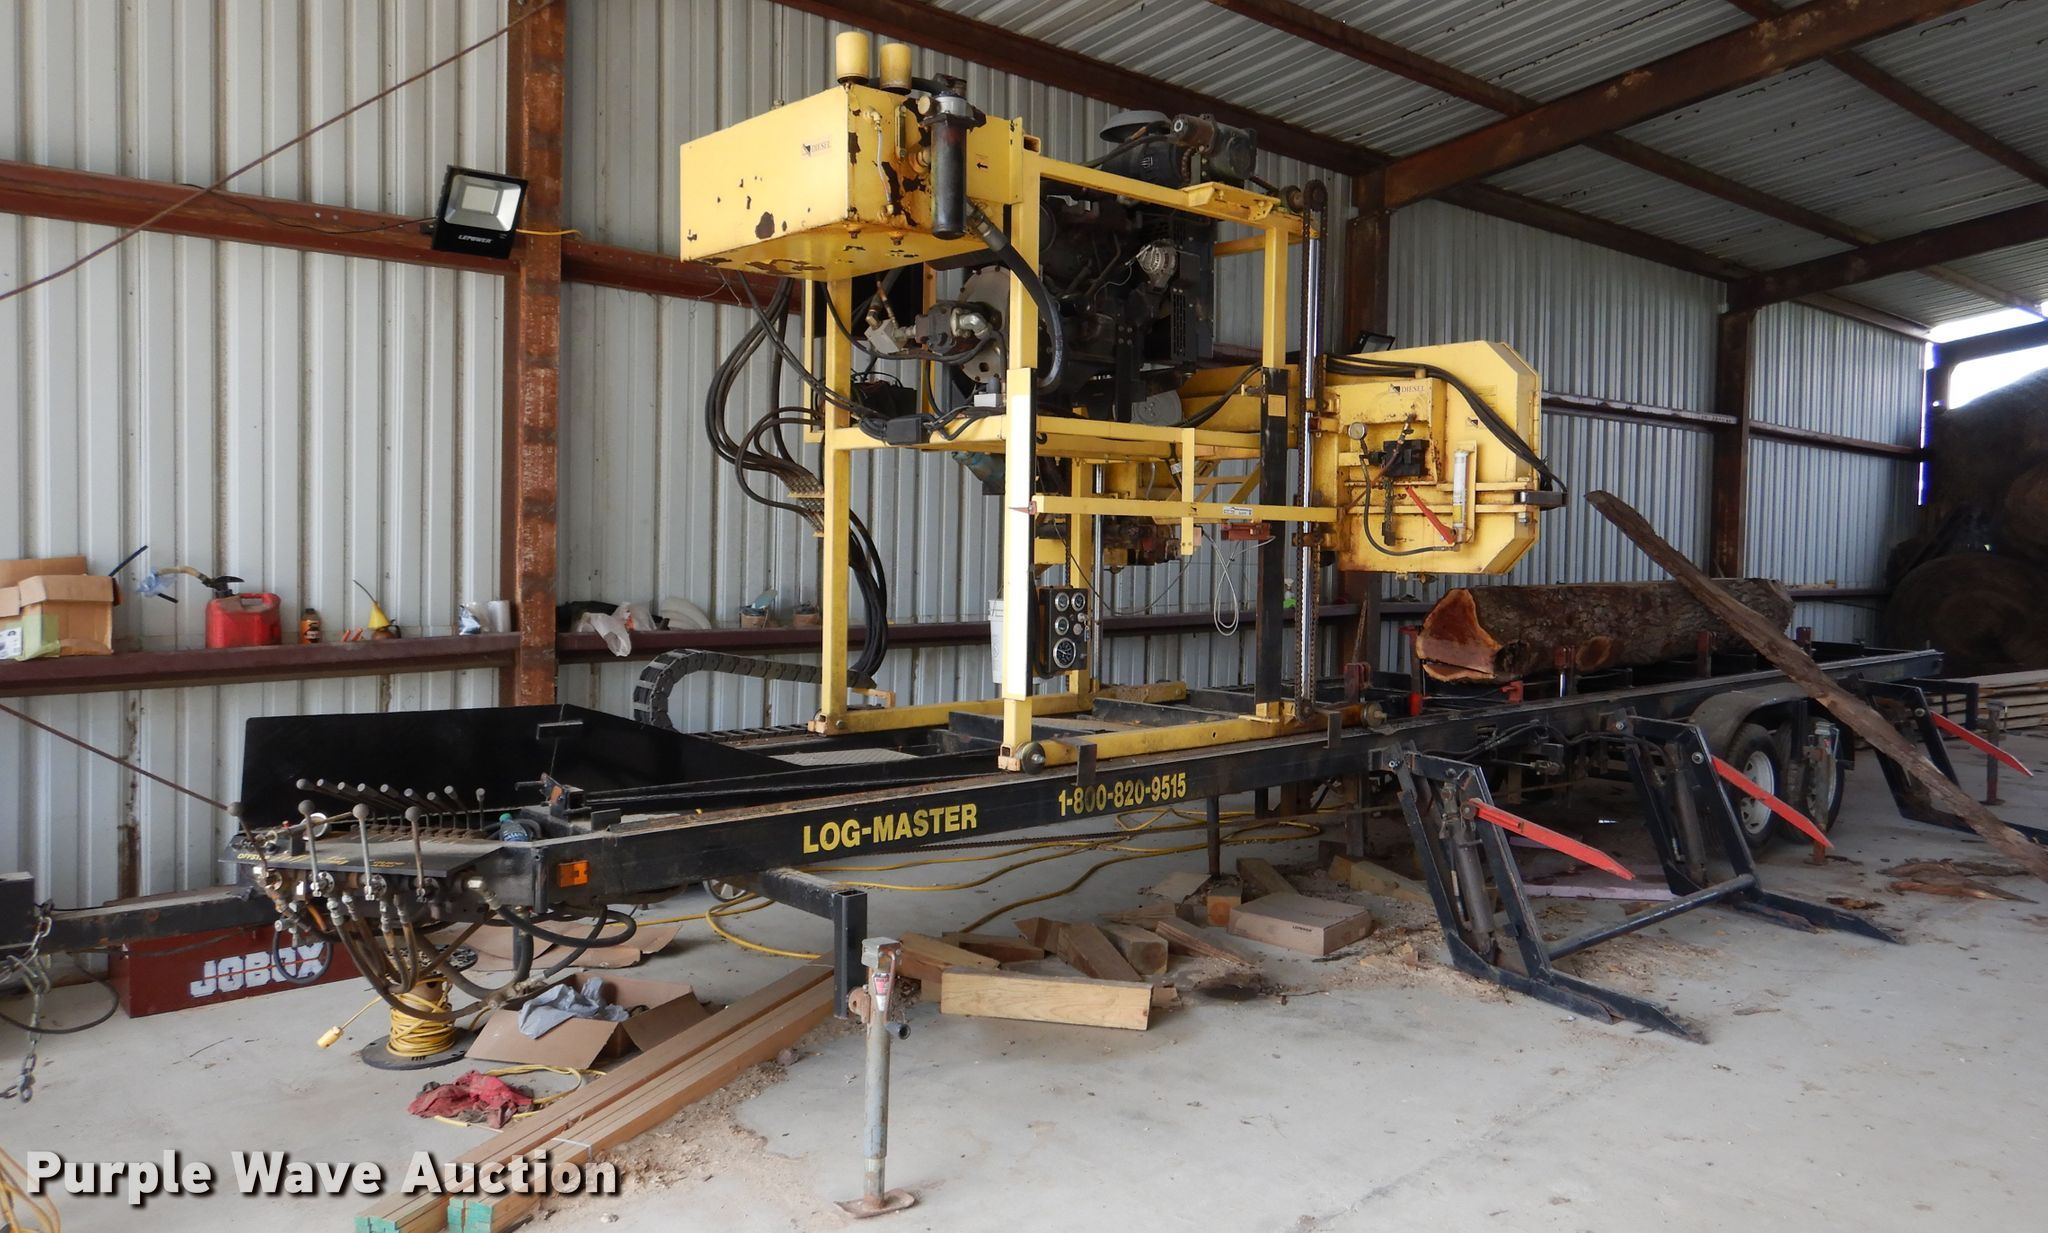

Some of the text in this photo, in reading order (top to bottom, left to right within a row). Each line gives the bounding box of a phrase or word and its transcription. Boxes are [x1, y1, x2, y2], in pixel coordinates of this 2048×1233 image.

[458, 234, 493, 244] LEPOWER
[1401, 385, 1425, 393] DIESEL
[1058, 772, 1187, 817] 1-800-820-9515
[803, 803, 977, 854] LOG-MASTER
[190, 941, 325, 998] JOBOX
